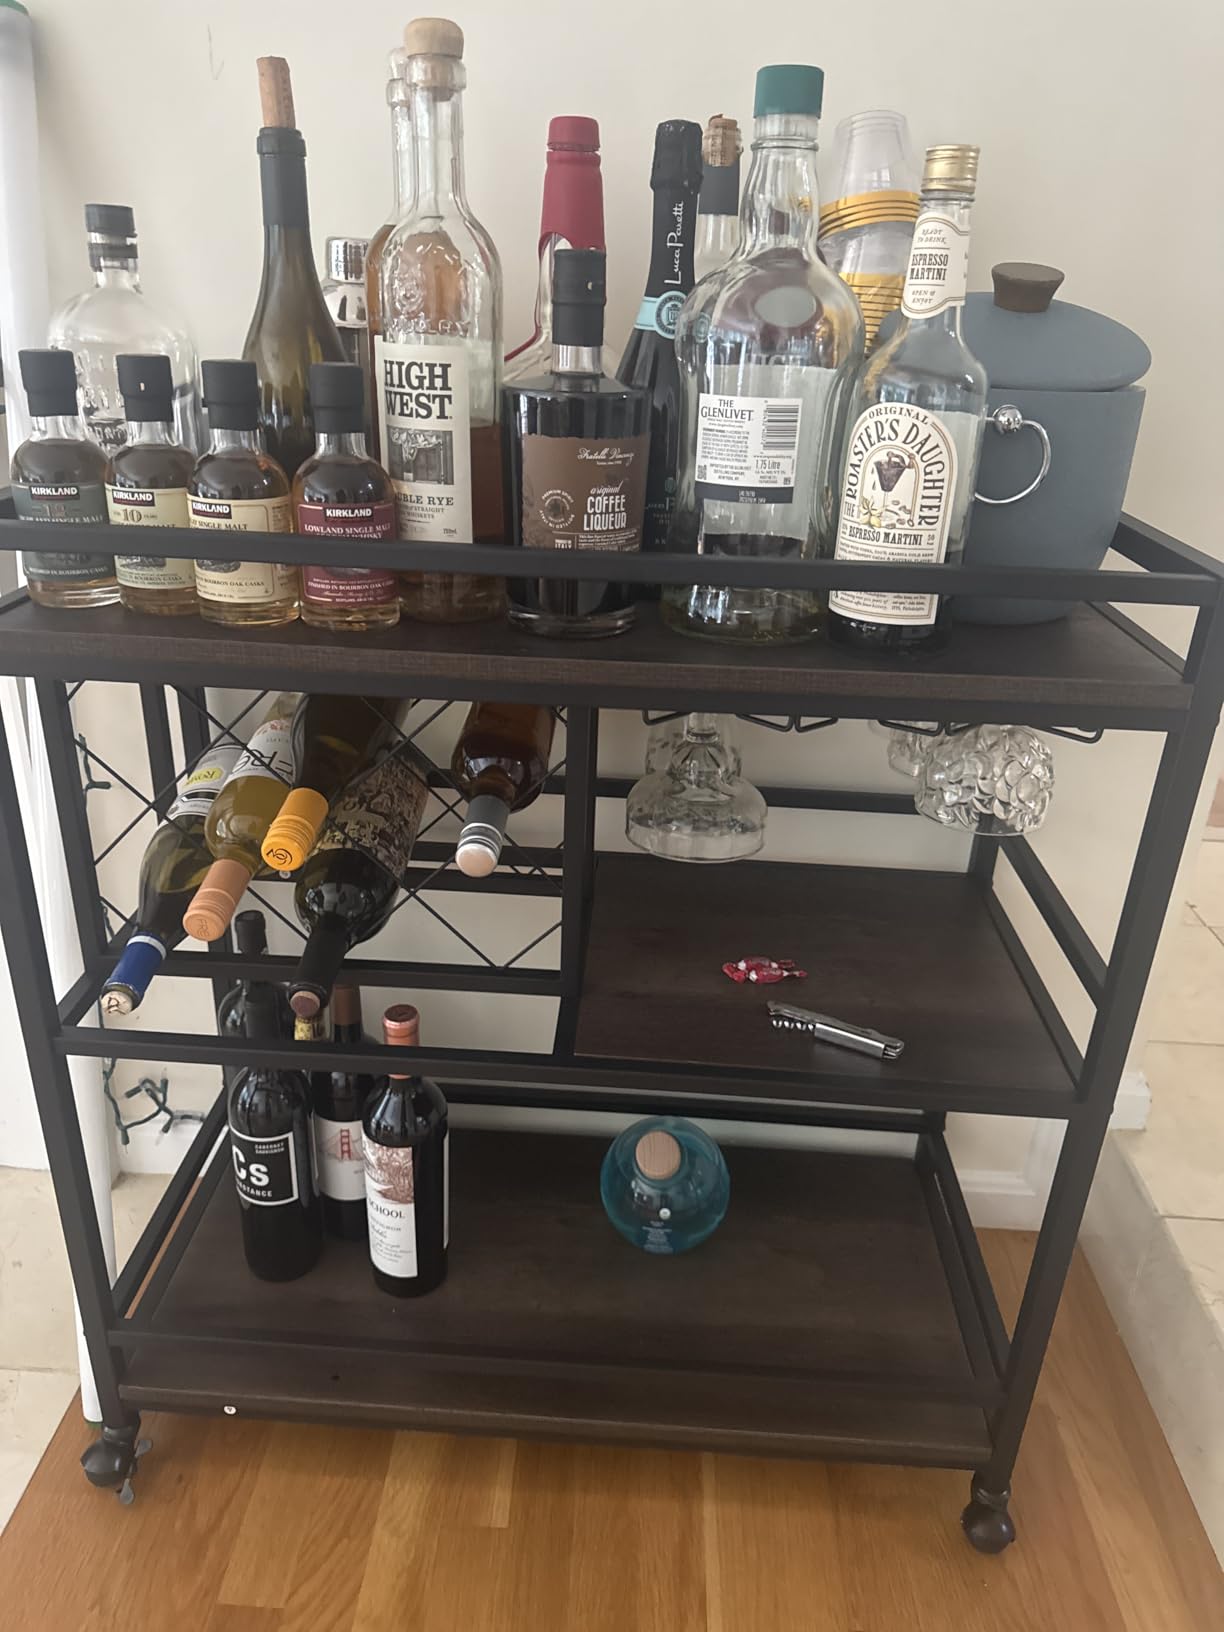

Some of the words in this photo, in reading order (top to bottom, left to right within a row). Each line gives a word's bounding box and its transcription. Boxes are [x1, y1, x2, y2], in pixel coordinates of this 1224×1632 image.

[667, 201, 684, 248] Paretti
[664, 248, 681, 284] Luca
[911, 253, 949, 266] ESPRESSO
[909, 268, 947, 280] MARTINI
[383, 359, 452, 391] HIGH
[385, 390, 452, 419] WEST
[718, 399, 734, 408] THE
[701, 406, 754, 421] GLENLIVET
[868, 406, 928, 425] ORIGINAL
[846, 418, 901, 502] ROASTER'S
[902, 422, 945, 526] DAUGHTER
[31, 486, 78, 497] KIRKLAND
[113, 491, 153, 501] KIRKLAND
[590, 480, 624, 498] original
[192, 502, 230, 514] KIRKLAND
[427, 496, 454, 506] RYE
[587, 495, 626, 513] COFFEE
[122, 508, 142, 523] 10
[326, 508, 372, 517] KIRKLAND
[583, 511, 627, 531] LIQUEUR
[304, 524, 343, 534] LOWLAND
[345, 526, 373, 534] SINGLE
[848, 525, 881, 543] ESPRESSO
[882, 531, 923, 546] MARTINI
